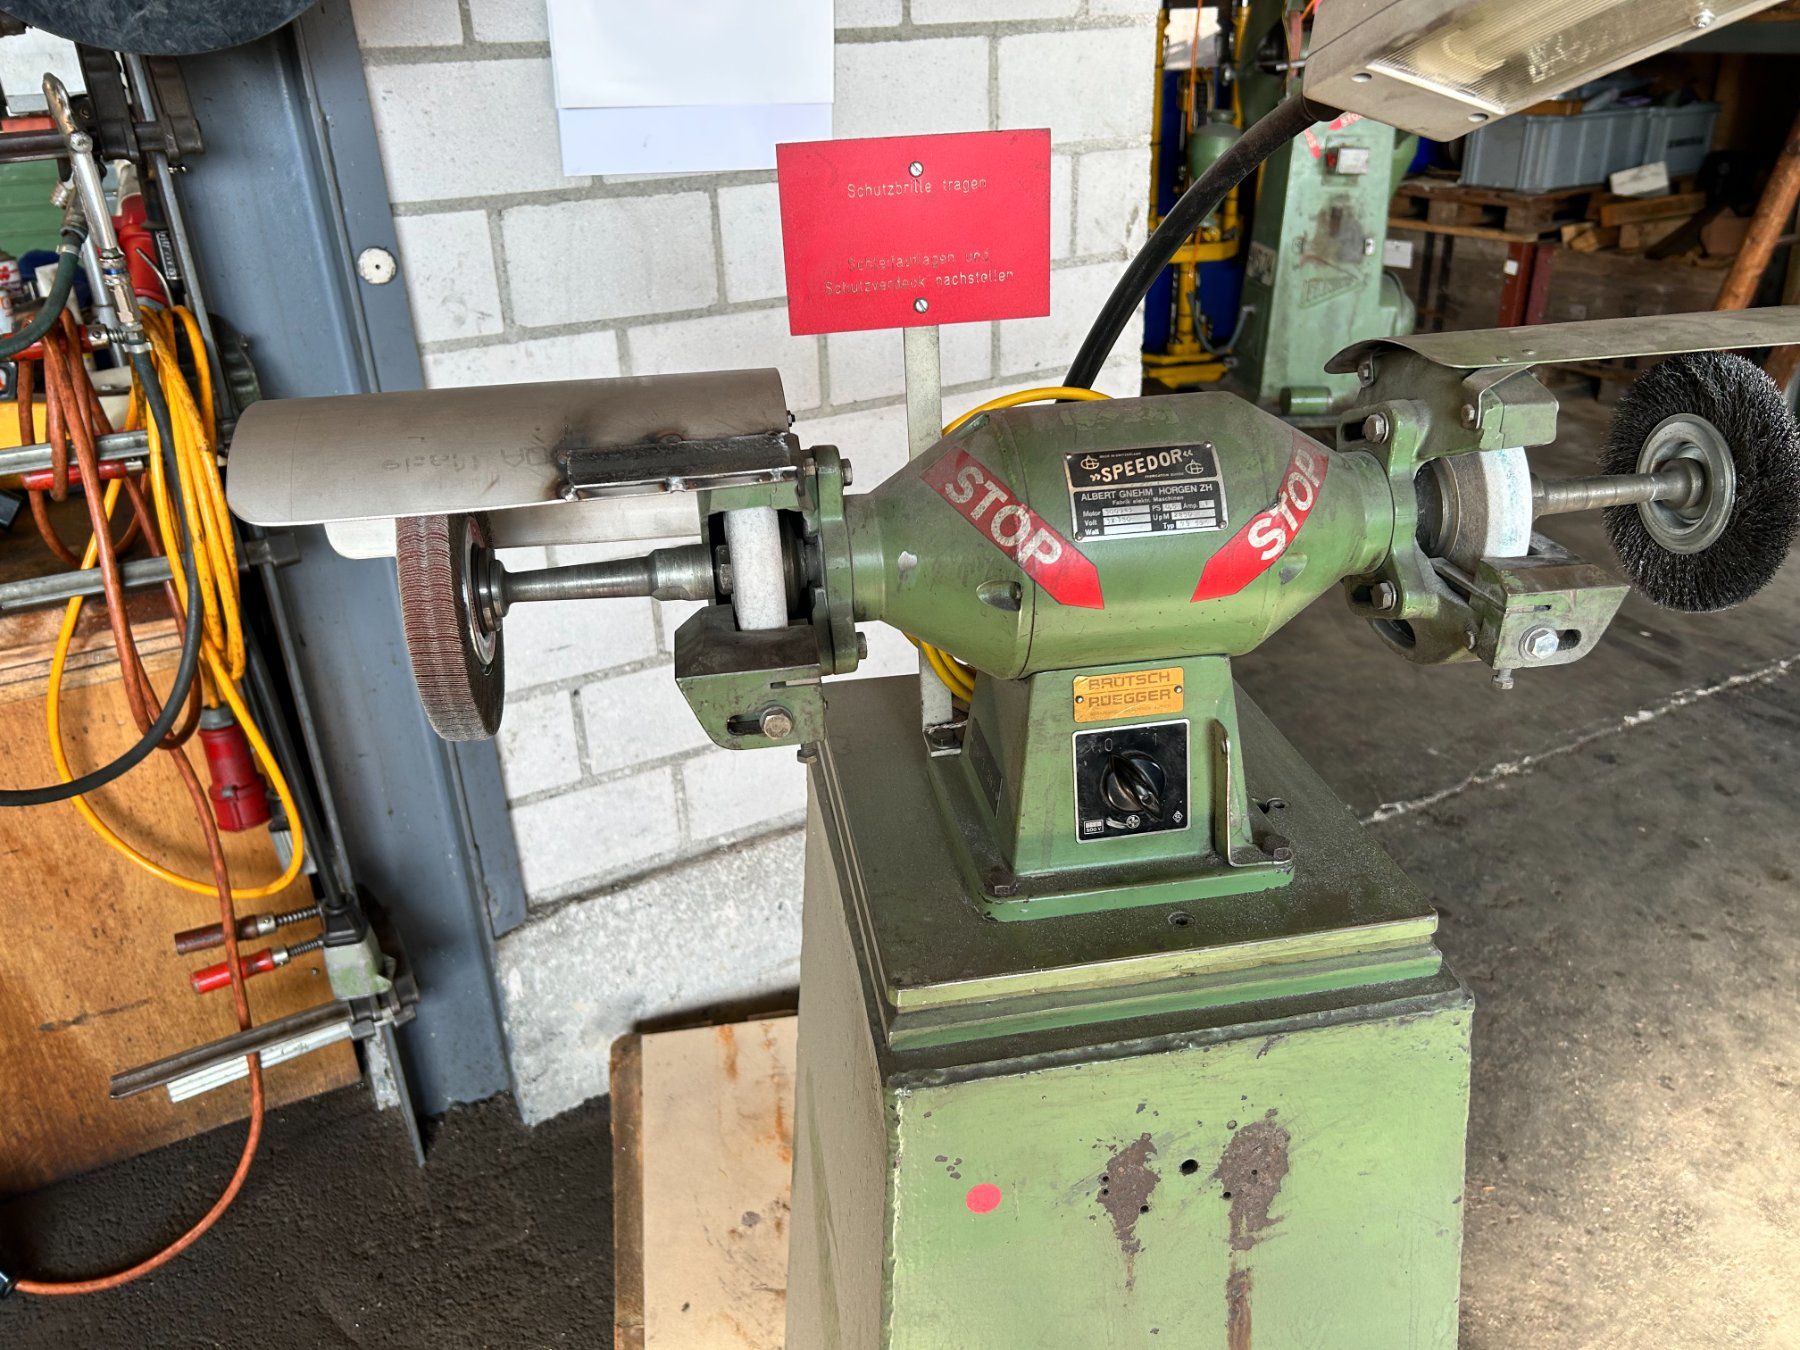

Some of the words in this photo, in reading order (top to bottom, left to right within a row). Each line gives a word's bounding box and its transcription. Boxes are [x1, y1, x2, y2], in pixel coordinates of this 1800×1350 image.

[847, 179, 932, 198] Schutzbrille
[942, 179, 987, 194] tragen
[936, 270, 1014, 287] nachstellen
[1081, 490, 1116, 502] ALBERT
[1119, 488, 1153, 498] GNEHM
[1159, 485, 1198, 495] HORGEN
[1199, 483, 1213, 492] ZH
[1152, 504, 1162, 512] PS
[1247, 449, 1321, 561] STOP
[944, 466, 1062, 565] STOP
[1088, 688, 1171, 708] RÜEGGER
